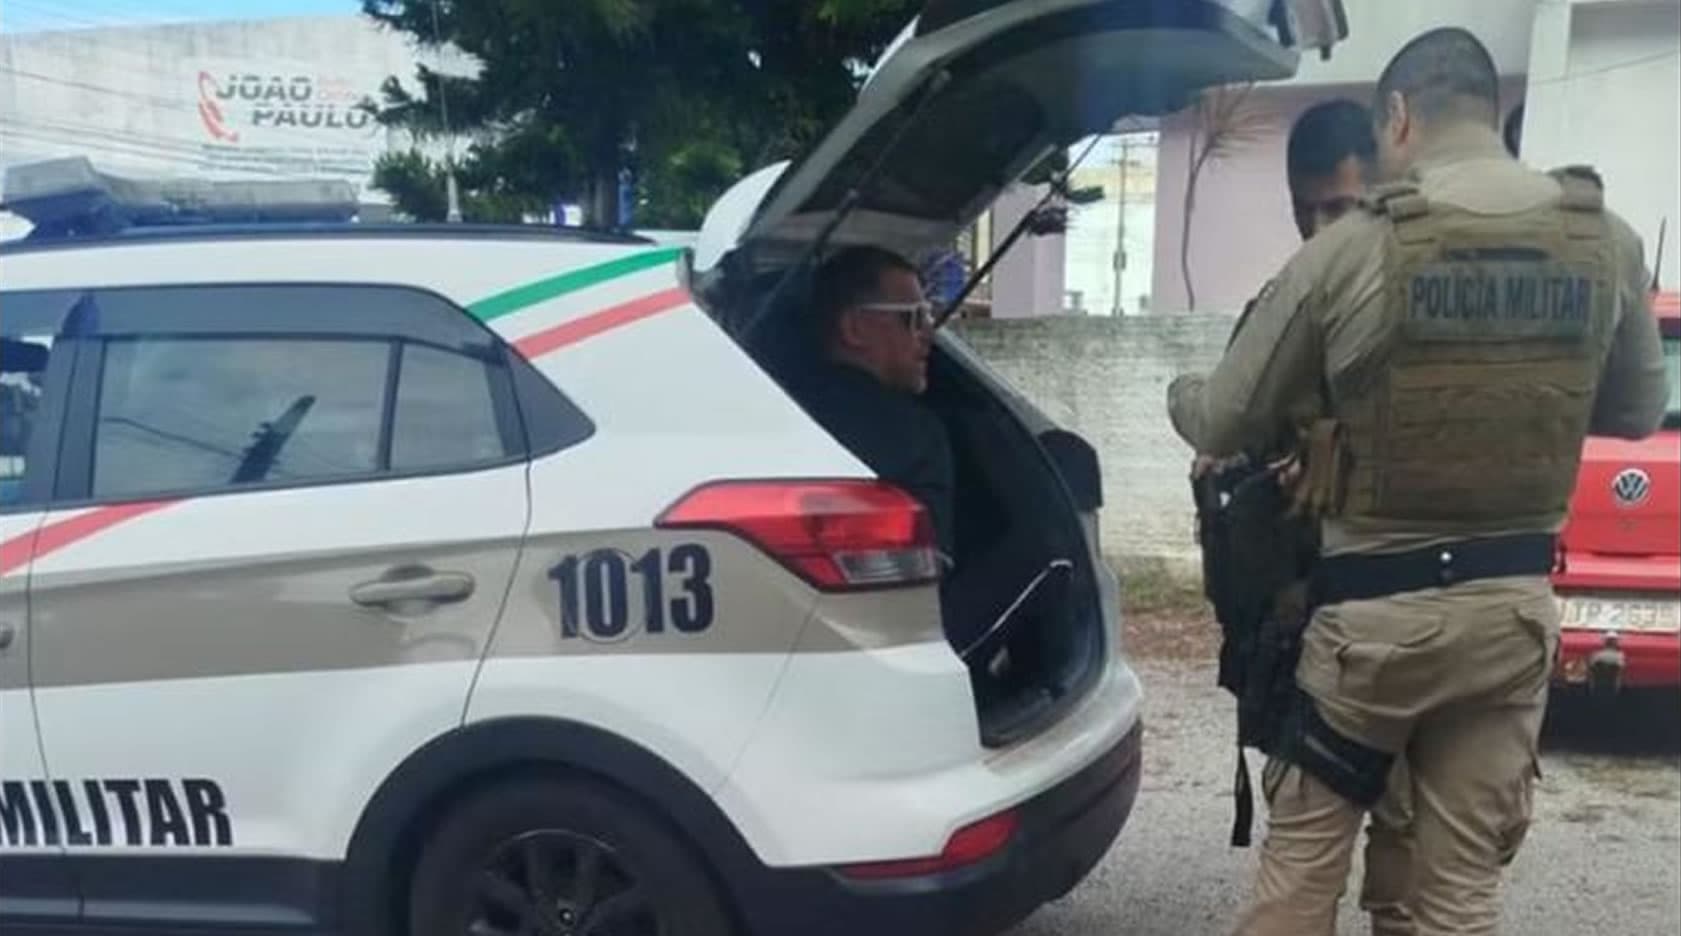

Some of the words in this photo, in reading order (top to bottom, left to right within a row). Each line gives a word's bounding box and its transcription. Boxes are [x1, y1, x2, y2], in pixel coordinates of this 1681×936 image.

[251, 103, 369, 129] PAULO
[1504, 275, 1592, 320] MILITAR
[547, 543, 714, 639] 1013
[0, 778, 233, 846] MILITAR
